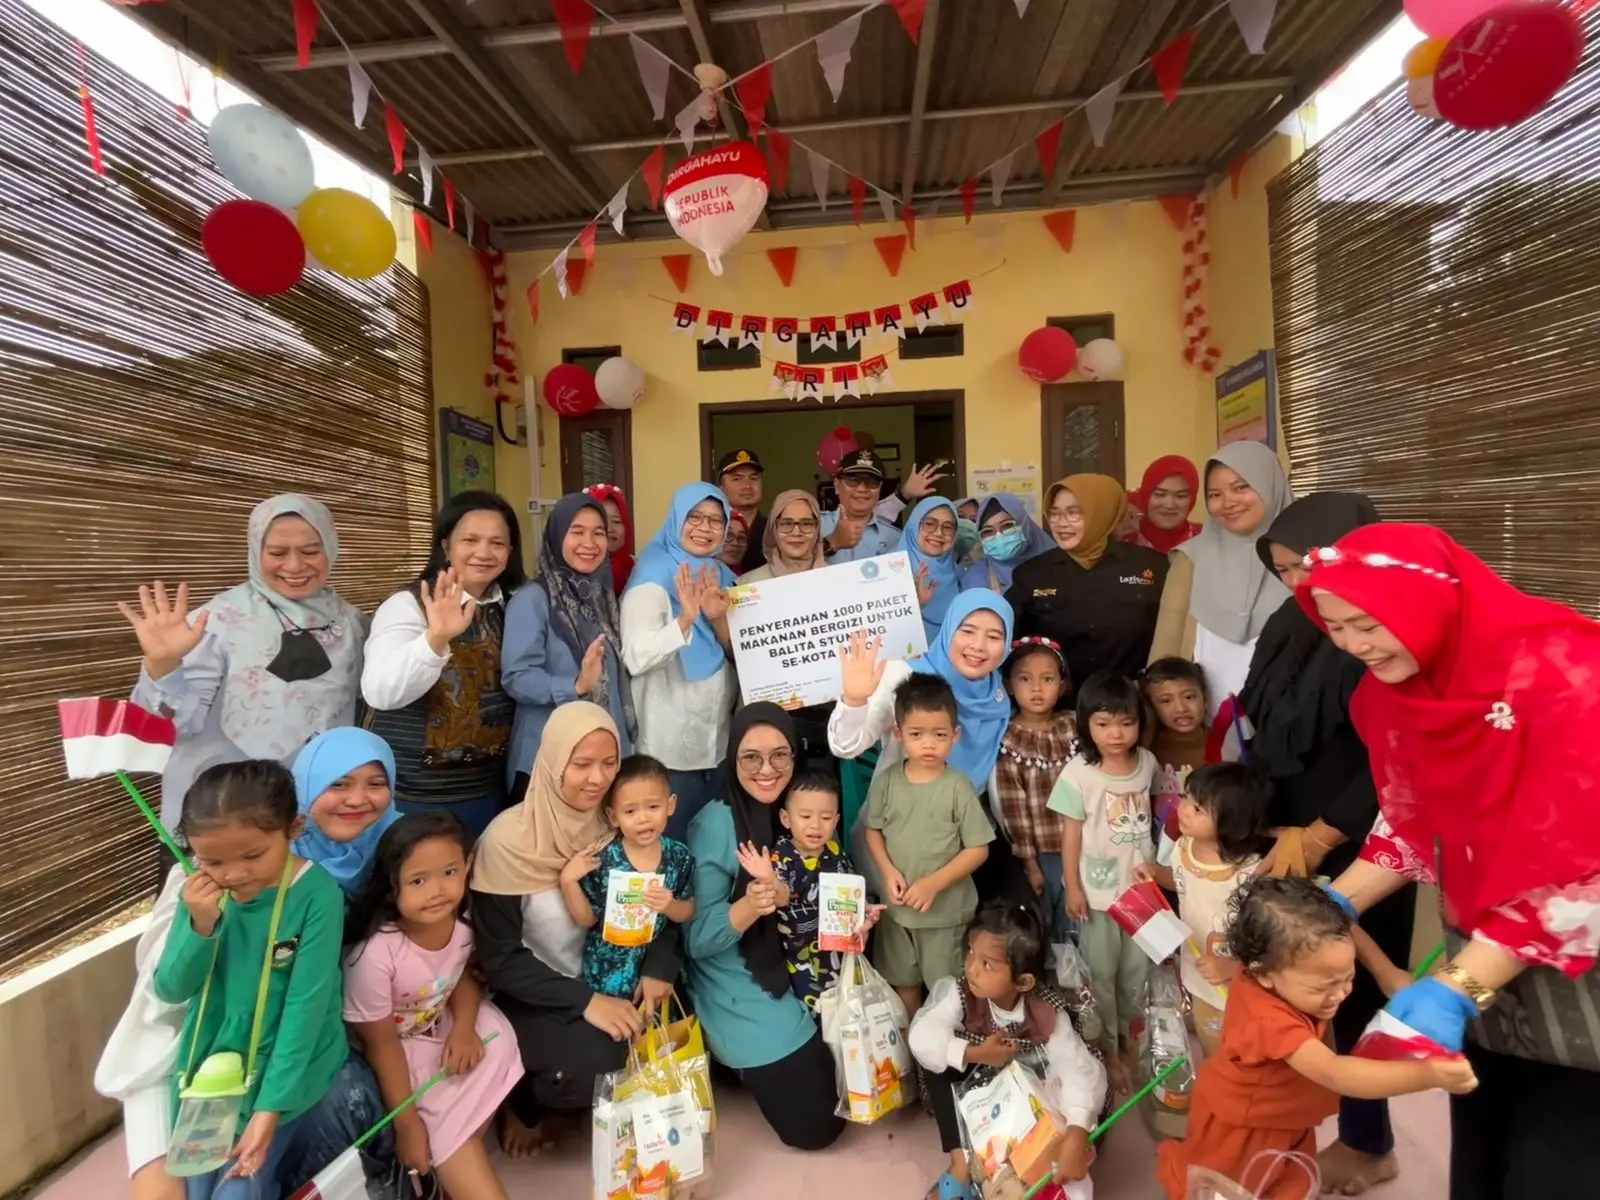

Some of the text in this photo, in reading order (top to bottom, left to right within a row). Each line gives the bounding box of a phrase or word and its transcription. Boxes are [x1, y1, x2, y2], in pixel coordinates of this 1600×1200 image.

[666, 150, 741, 186] DIRGAHAYU
[678, 200, 736, 227] NDONESIA
[678, 288, 968, 343] DIRGAHAYU
[803, 371, 849, 393] RI
[739, 594, 909, 638] PENYERAHAN 1000 PAKET
[740, 606, 914, 651] MAKANAN BERGIZI UNTUK
[769, 641, 816, 659] BALITA
[820, 625, 888, 648] STUNTNG
[782, 650, 837, 669] SE-KOTA
